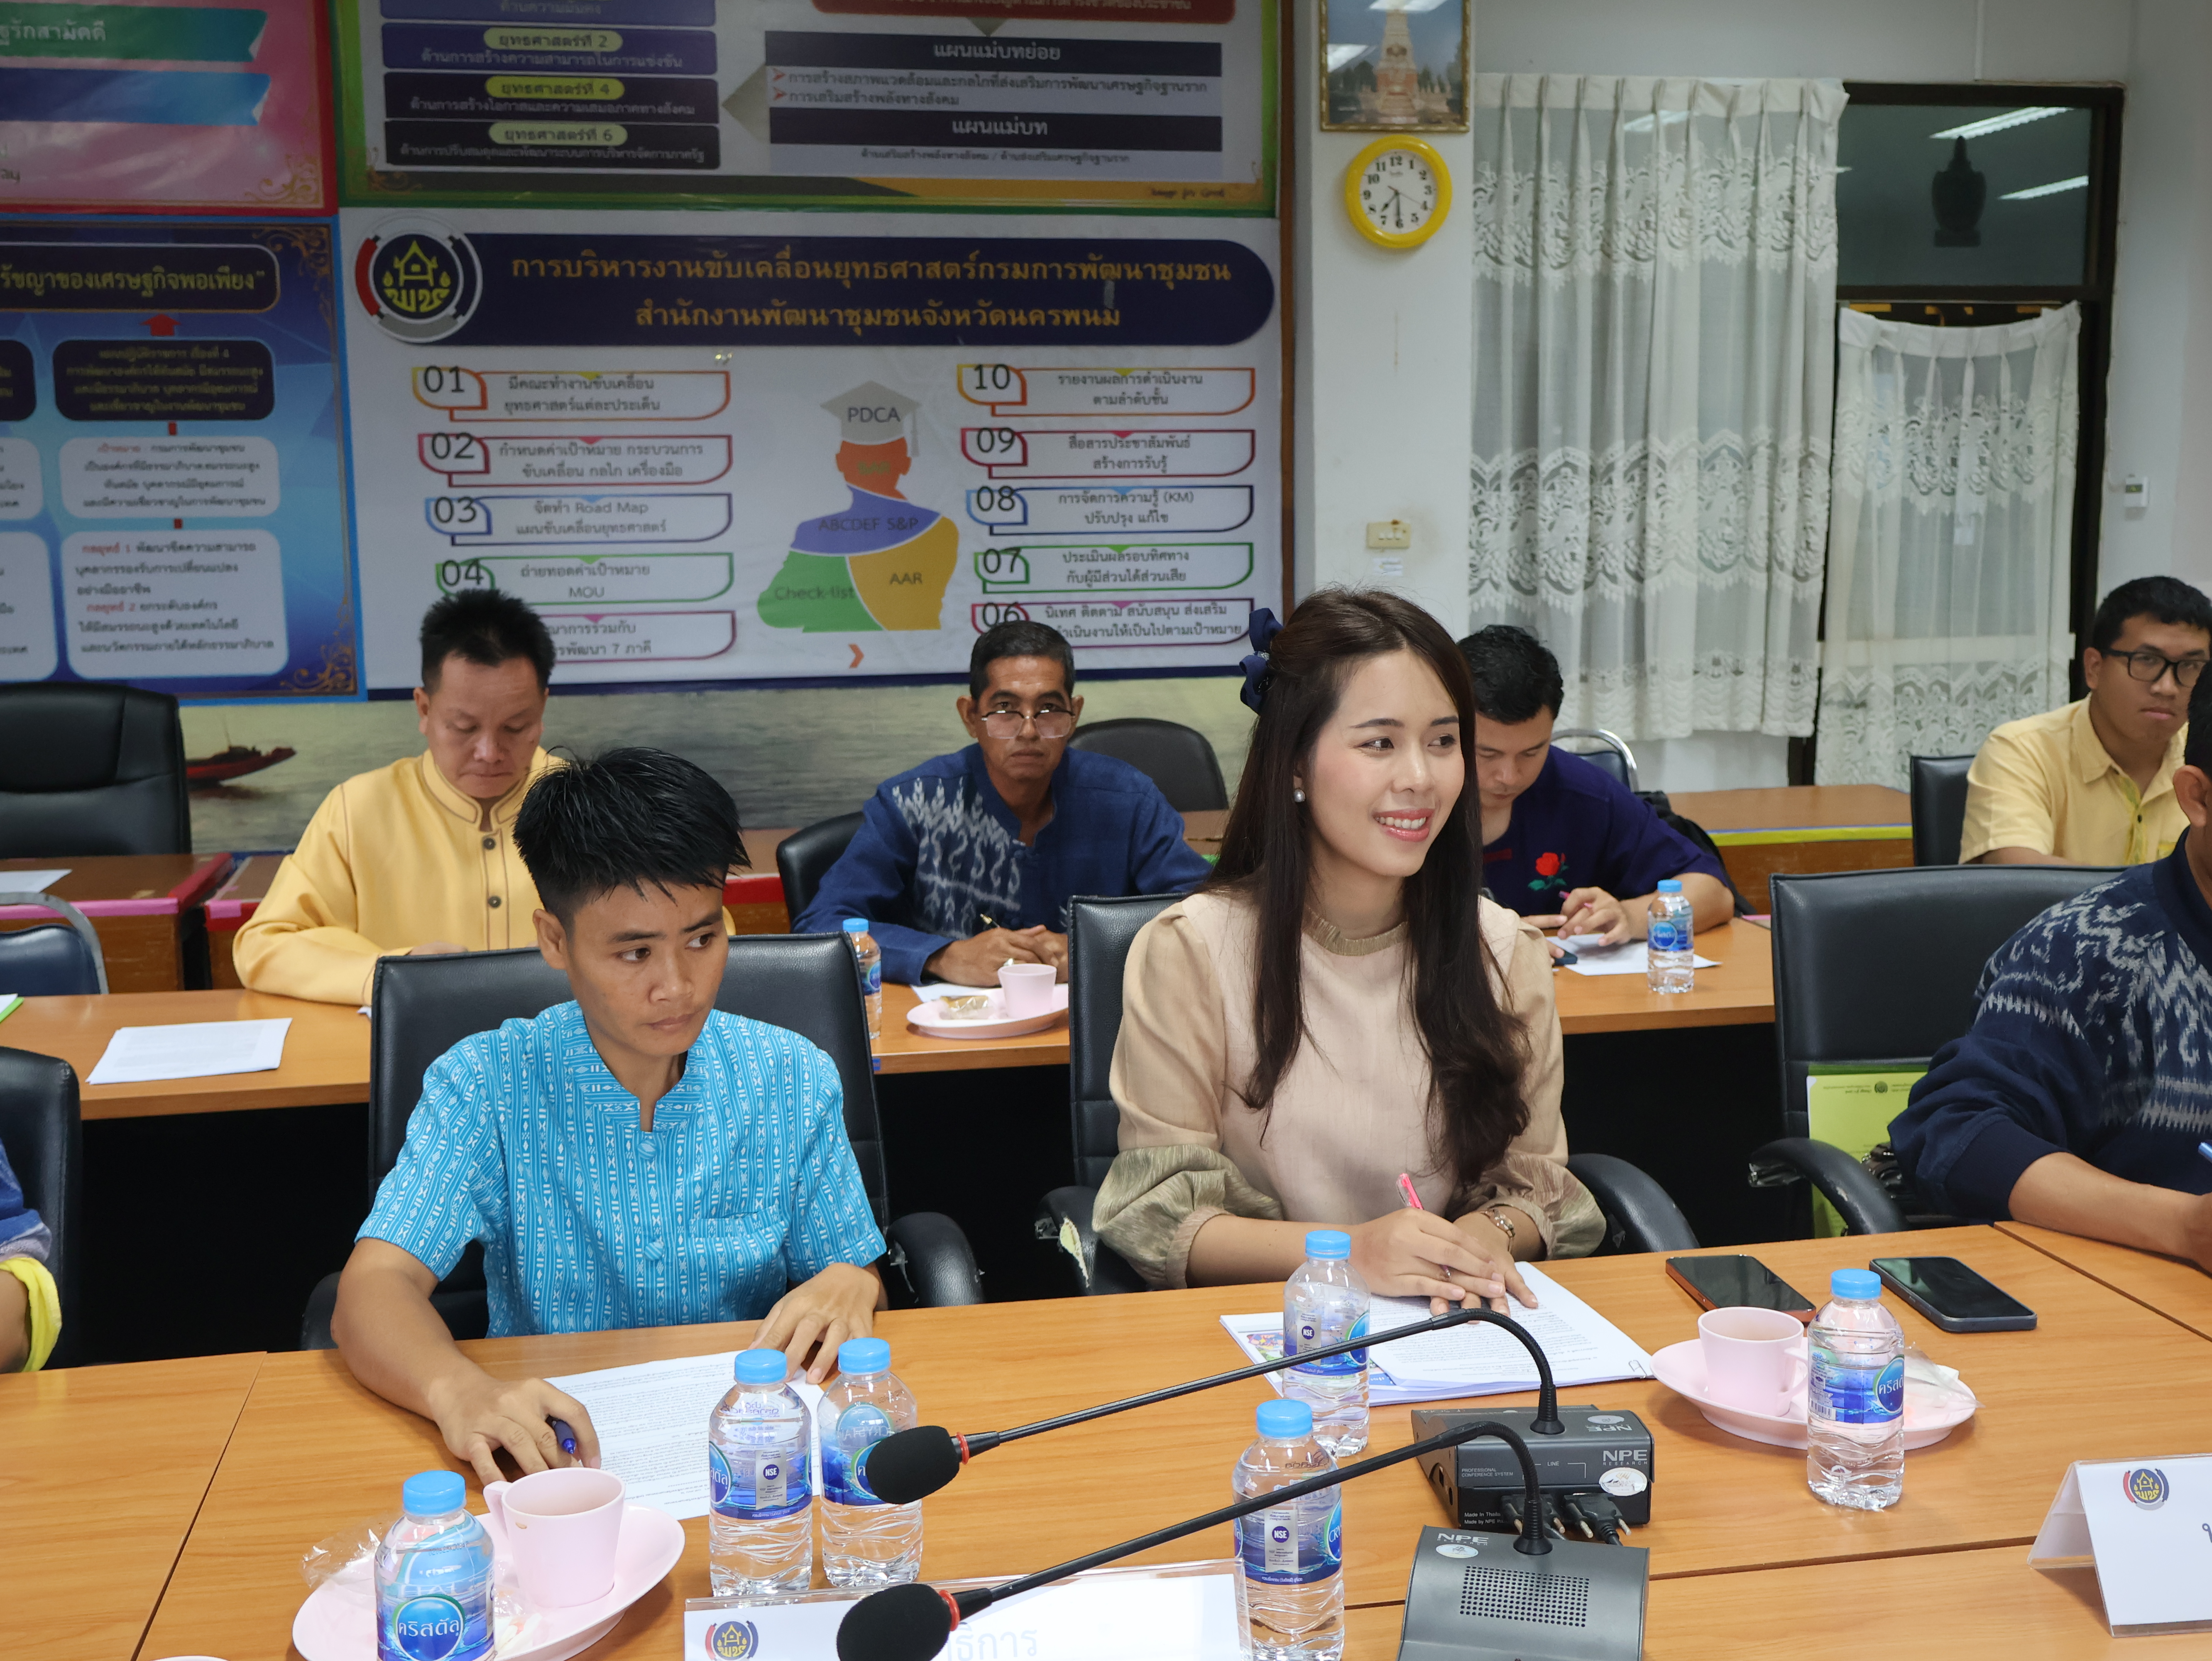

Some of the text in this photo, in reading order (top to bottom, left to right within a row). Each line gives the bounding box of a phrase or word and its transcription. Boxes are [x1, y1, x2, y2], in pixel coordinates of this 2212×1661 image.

[598, 35, 607, 47] 2
[934, 40, 1061, 63] แผนแม่บทย่อย
[600, 84, 610, 96] 4
[603, 130, 613, 141] 6
[952, 117, 1048, 138] แผนแม่บท
[511, 245, 1232, 290] การบริหารงานขับเคลื่อนยุทธศาสตร์กรมการพัฒนาชุมชน
[635, 298, 1121, 337] สำนักงานพัฒนาชุมชนจังหวัดนครพนม
[423, 365, 466, 393] 01
[508, 372, 655, 390] มีคณะทำงานขับเคลื่อน
[973, 364, 1011, 390] 10
[1058, 372, 1203, 386] รายงานผลการดำเนินงาน
[1093, 388, 1169, 406] ตามลำดับชั้น
[847, 407, 901, 423] PDCA
[432, 433, 475, 459] 02
[977, 427, 1015, 453] 09
[627, 443, 704, 456] กระบวนการ
[523, 462, 683, 477] ขับเคลื่อน กลไก เครื่องมือ
[1093, 456, 1168, 474] สร้างการรับรู้
[976, 486, 1015, 511] 08
[1058, 490, 1194, 507] การจัดการความรู้ (KM)
[433, 497, 477, 524] 03
[535, 500, 649, 516] จัดทำ Road Map
[818, 517, 919, 531] ABCDEF S&P
[1085, 510, 1169, 527] ปรับปรุง แก้ไข
[516, 519, 668, 537] แผนขับเคลื่อนยุทธศาสตร์
[982, 548, 1022, 574] 07
[442, 559, 484, 586] 04
[520, 562, 650, 578] ถ่ายทอดค่าเป้าหมาย
[890, 572, 922, 586] AAR
[568, 586, 604, 598] MOU
[1082, 604, 1122, 618] ติดตาม
[1126, 604, 1180, 620] สนับสนุน
[1185, 601, 1228, 615] ส่งเสริม
[1058, 622, 1242, 637] ำเนินงานให้เป็นไปตามเป้าหมาย
[612, 643, 620, 654] 7
[626, 639, 652, 655] ภาคี
[1603, 1450, 1648, 1461] NPE
[1437, 1533, 1489, 1544] NPE
[399, 1617, 460, 1637] คริสตัล
